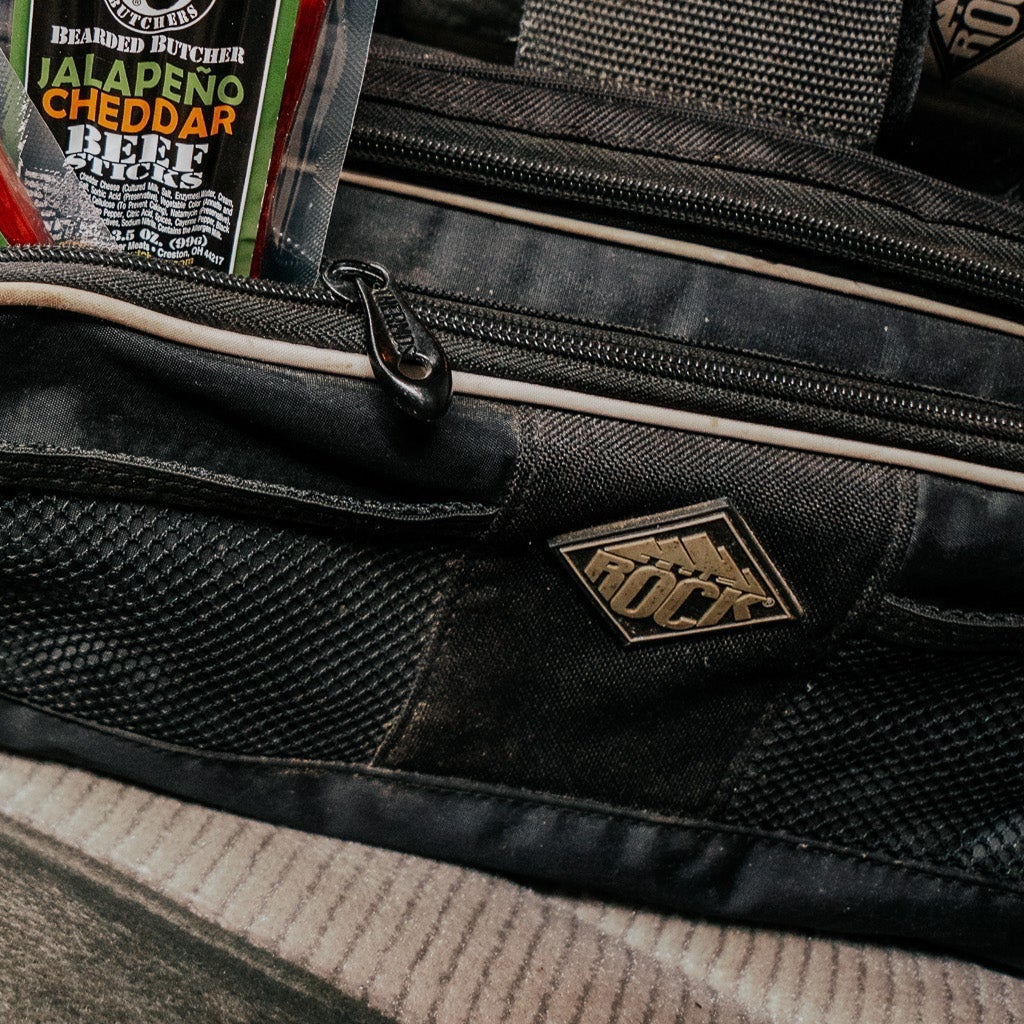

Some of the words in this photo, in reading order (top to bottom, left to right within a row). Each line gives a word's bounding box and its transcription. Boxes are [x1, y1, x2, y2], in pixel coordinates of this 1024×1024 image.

[50, 25, 145, 54] BEARDED
[150, 34, 245, 65] BUTCHER
[37, 53, 244, 107] JALAPEÑO
[42, 87, 236, 140] CHEDDAR
[63, 152, 204, 189] STICKS
[65, 123, 209, 173] BEEF
[191, 246, 204, 256] OH
[584, 549, 766, 629] ROCK
